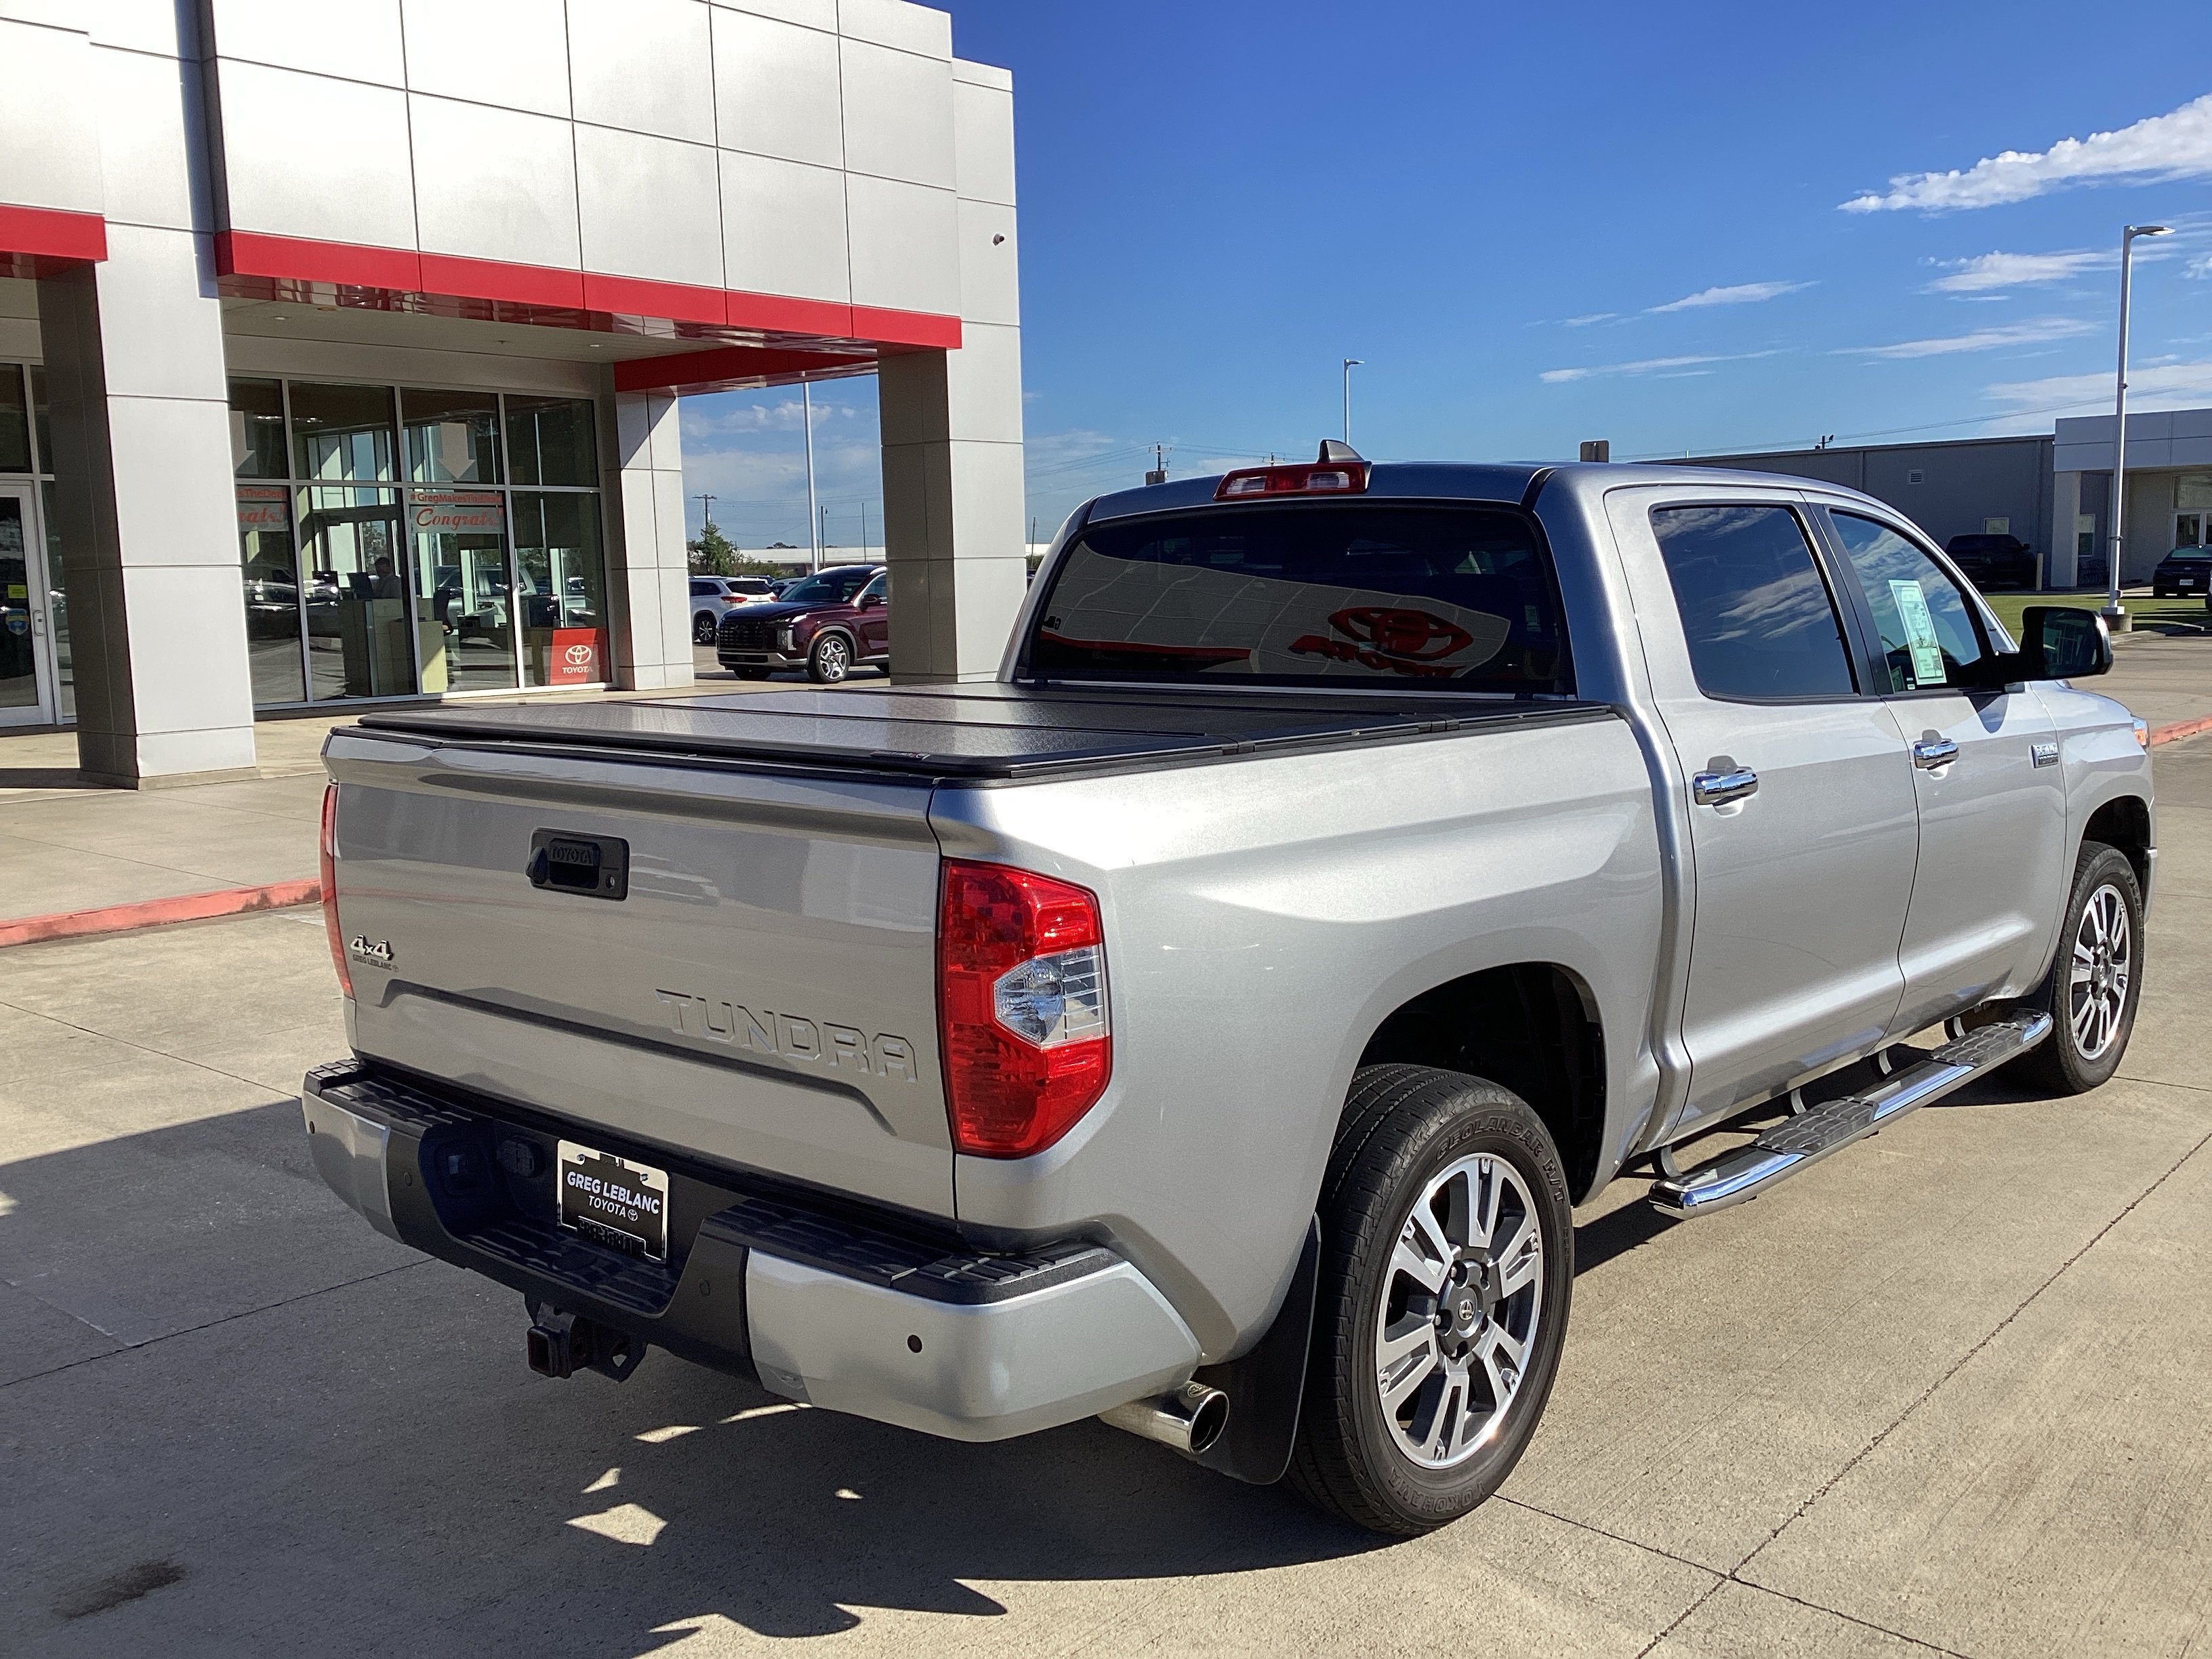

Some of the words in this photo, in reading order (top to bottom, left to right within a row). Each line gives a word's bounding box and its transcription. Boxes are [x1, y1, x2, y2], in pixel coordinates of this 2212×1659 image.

[562, 665, 594, 674] TOYOTA
[551, 846, 593, 865] TOYOTA
[350, 933, 395, 961] 4x4
[655, 988, 918, 1083] TUNDRA
[567, 1171, 601, 1193] GREG
[602, 1182, 660, 1214] LEBLANC
[588, 1195, 626, 1218] TOYOTA
[1388, 1466, 1486, 1513] YOKOHAMA
